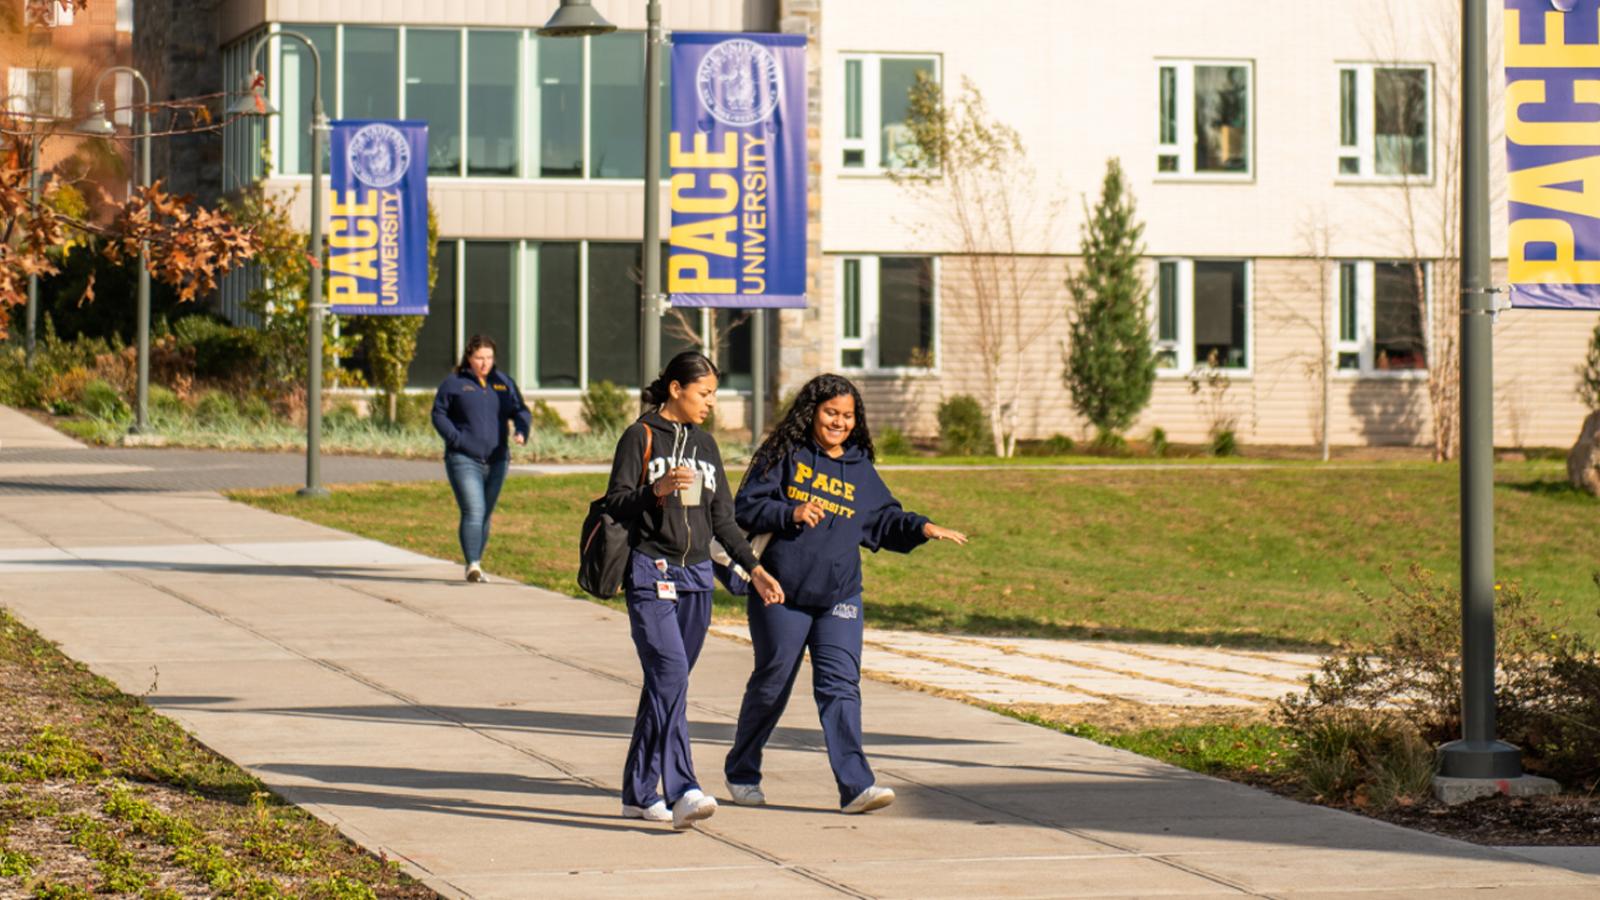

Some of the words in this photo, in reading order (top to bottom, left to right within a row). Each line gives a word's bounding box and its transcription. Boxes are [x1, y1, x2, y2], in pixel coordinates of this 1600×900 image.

[669, 131, 739, 294] PACE
[742, 132, 767, 294] UNIVERSITY
[1504, 8, 1600, 284] PACE
[328, 189, 379, 305] PACE
[381, 190, 399, 306] UNIVERSITY
[794, 462, 855, 502] PACE
